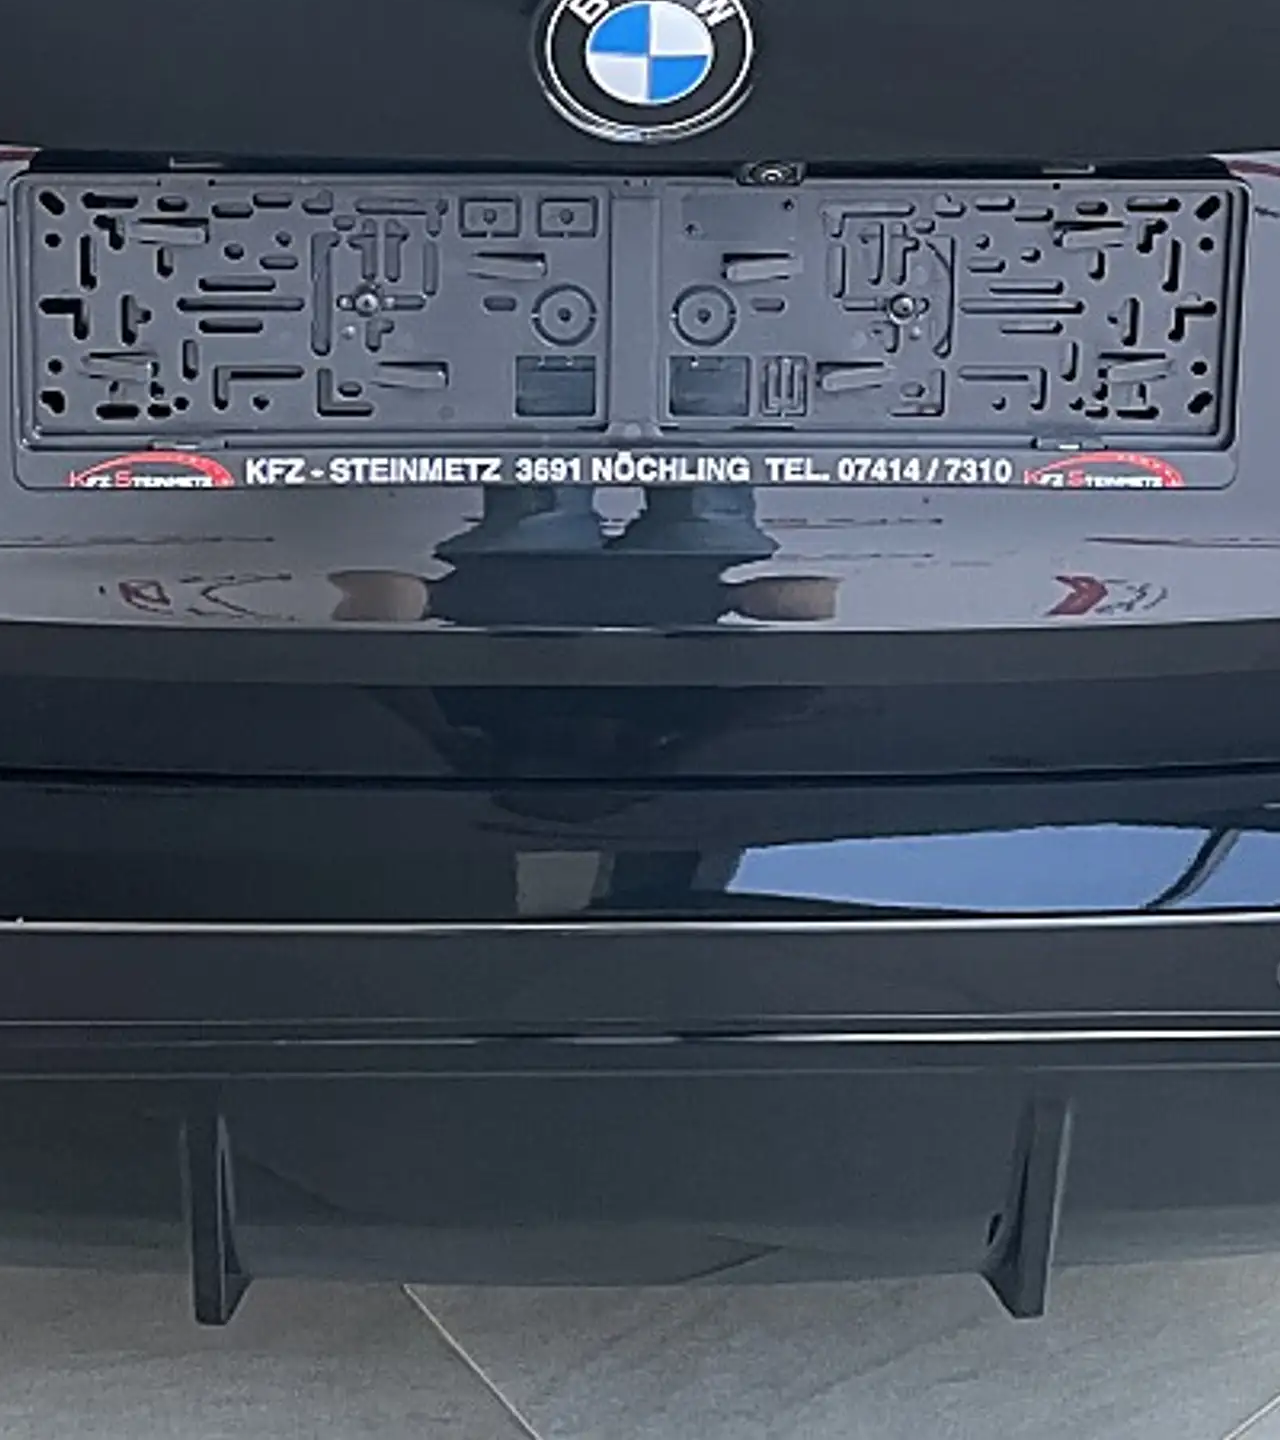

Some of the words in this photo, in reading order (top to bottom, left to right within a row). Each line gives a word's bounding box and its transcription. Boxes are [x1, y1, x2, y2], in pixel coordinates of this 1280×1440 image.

[245, 457, 306, 484] KFZ
[329, 457, 502, 484] STEINMETZ
[515, 458, 581, 483] 3691
[591, 451, 750, 482] NÖCHLING
[765, 457, 830, 482] TEL.
